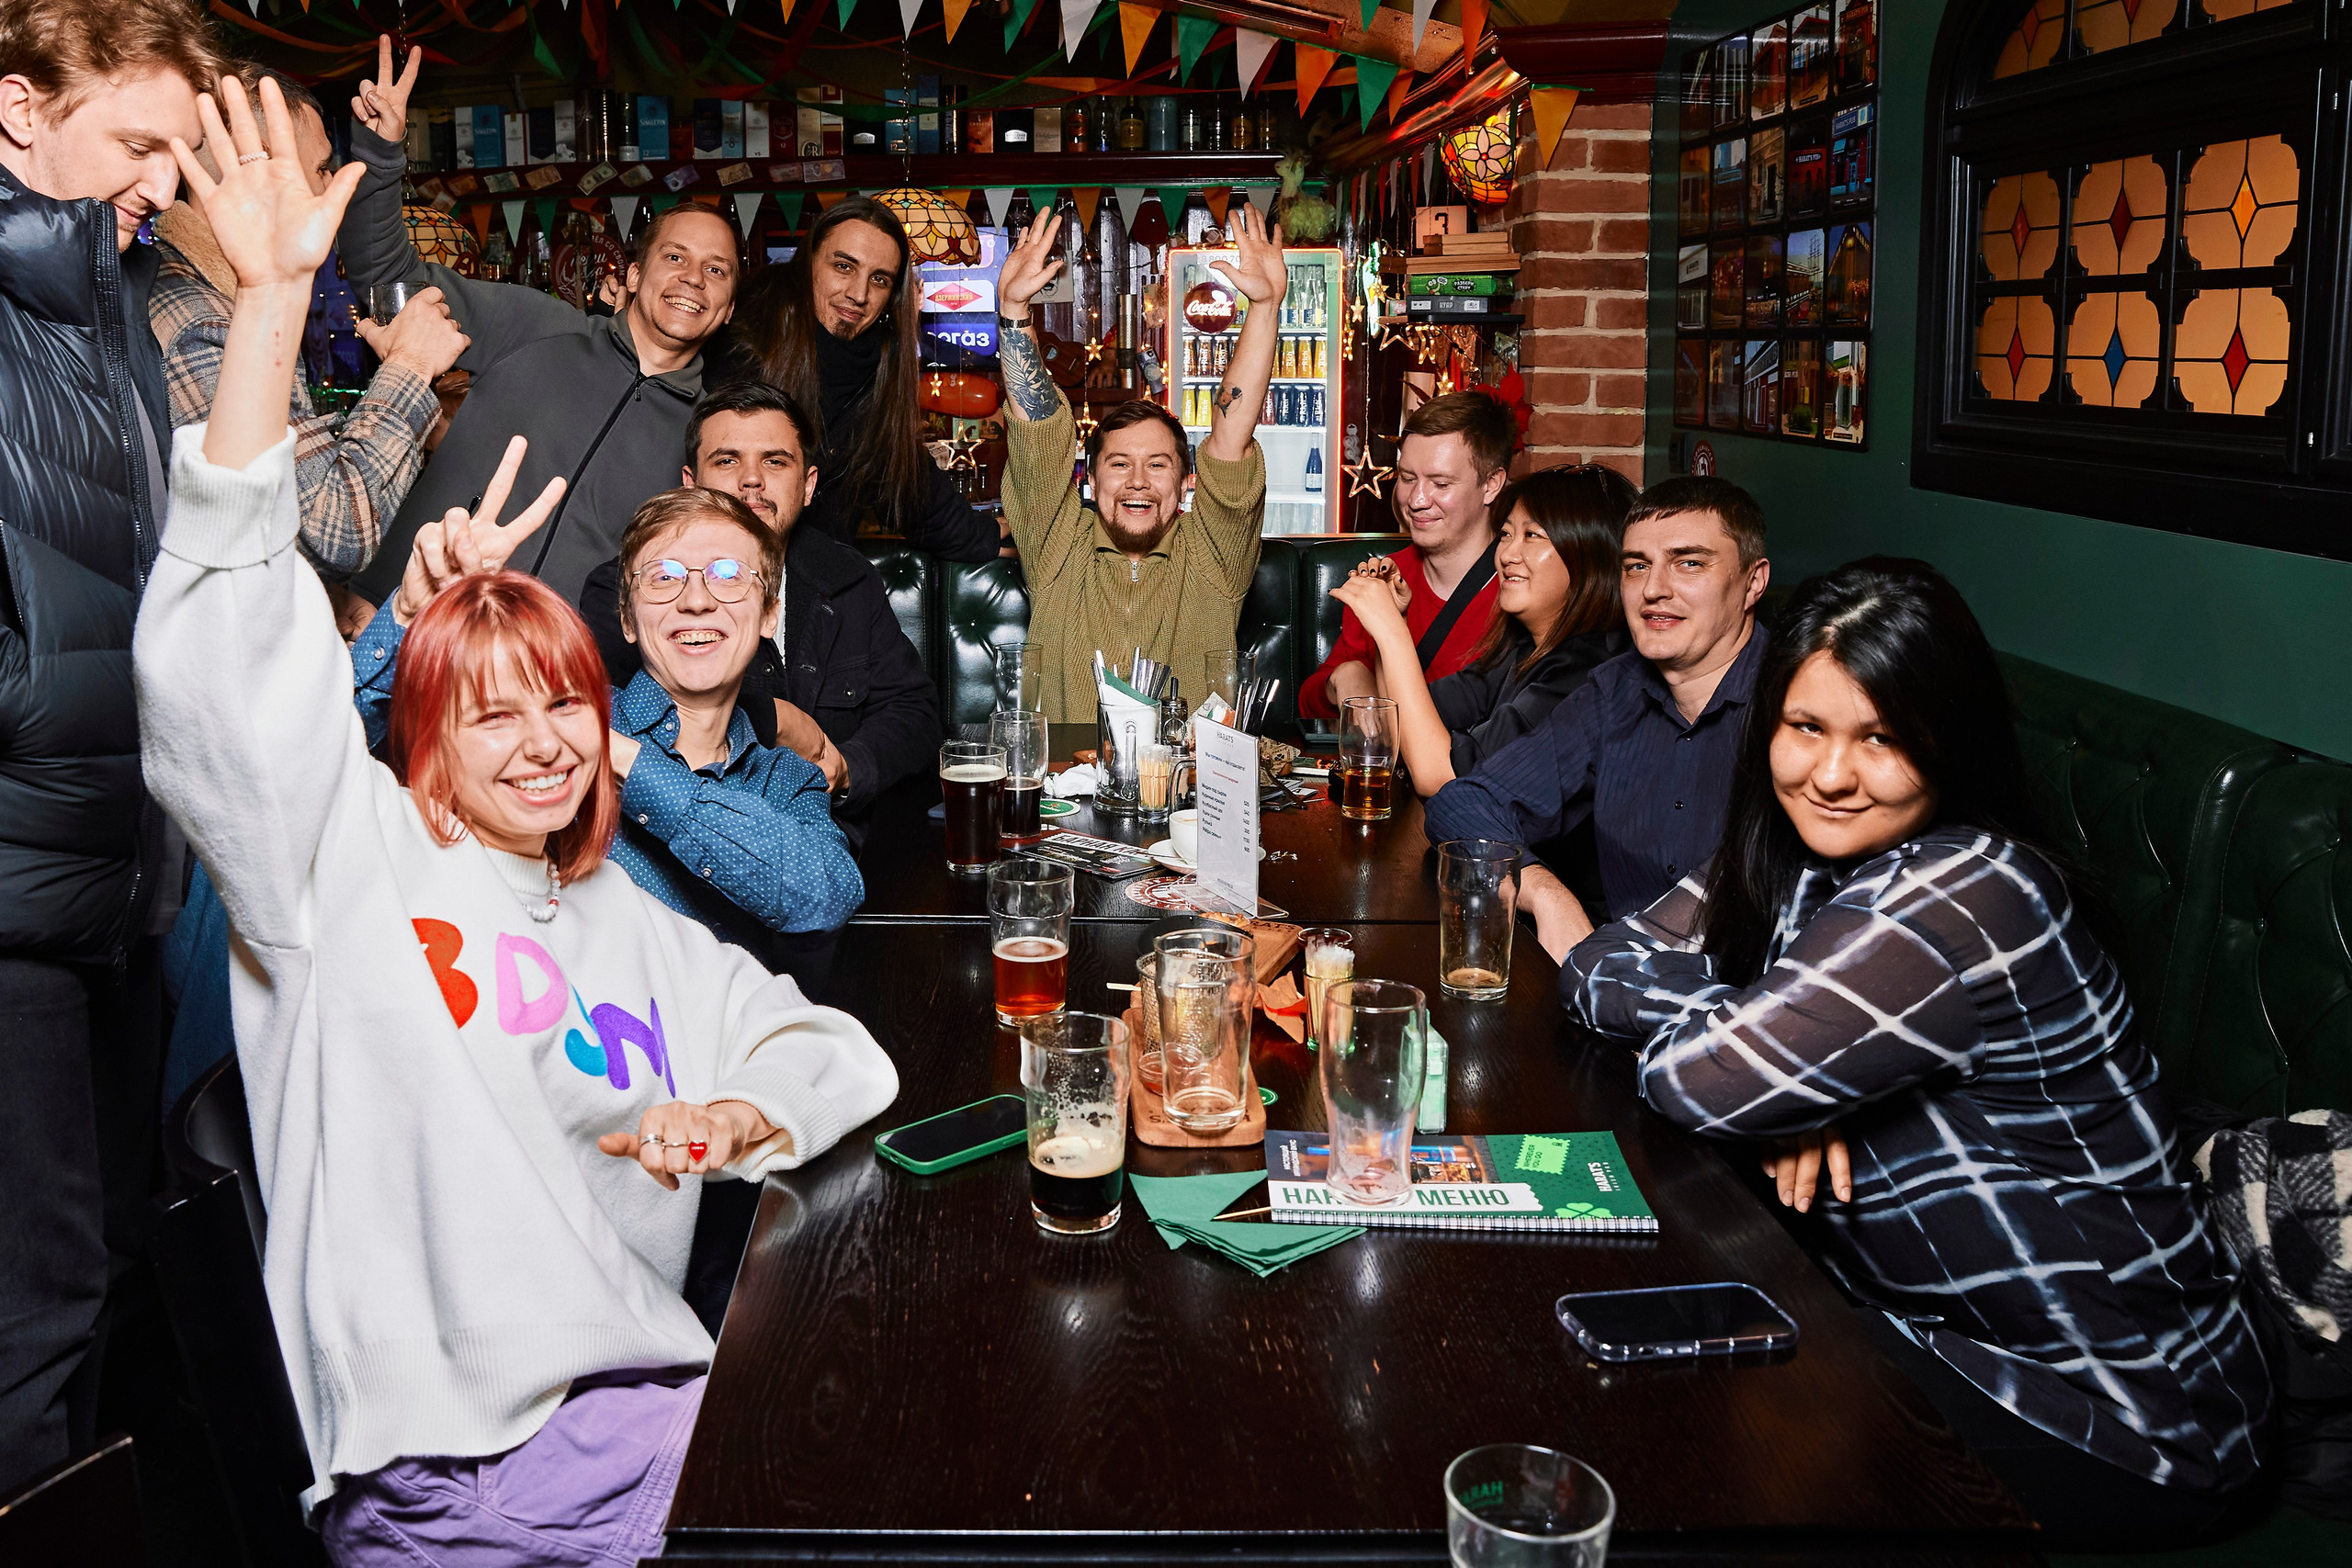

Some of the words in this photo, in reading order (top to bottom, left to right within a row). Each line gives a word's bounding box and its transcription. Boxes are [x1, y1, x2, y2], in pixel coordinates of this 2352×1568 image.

[927, 330, 990, 347] огаз
[1216, 731, 1234, 744] HARATS
[1054, 833, 1114, 852] БАРНАЯ
[1250, 920, 1295, 930] RATS
[1523, 1144, 1535, 1168] WHEREVER
[1418, 1189, 1510, 1206] МЕНЮ
